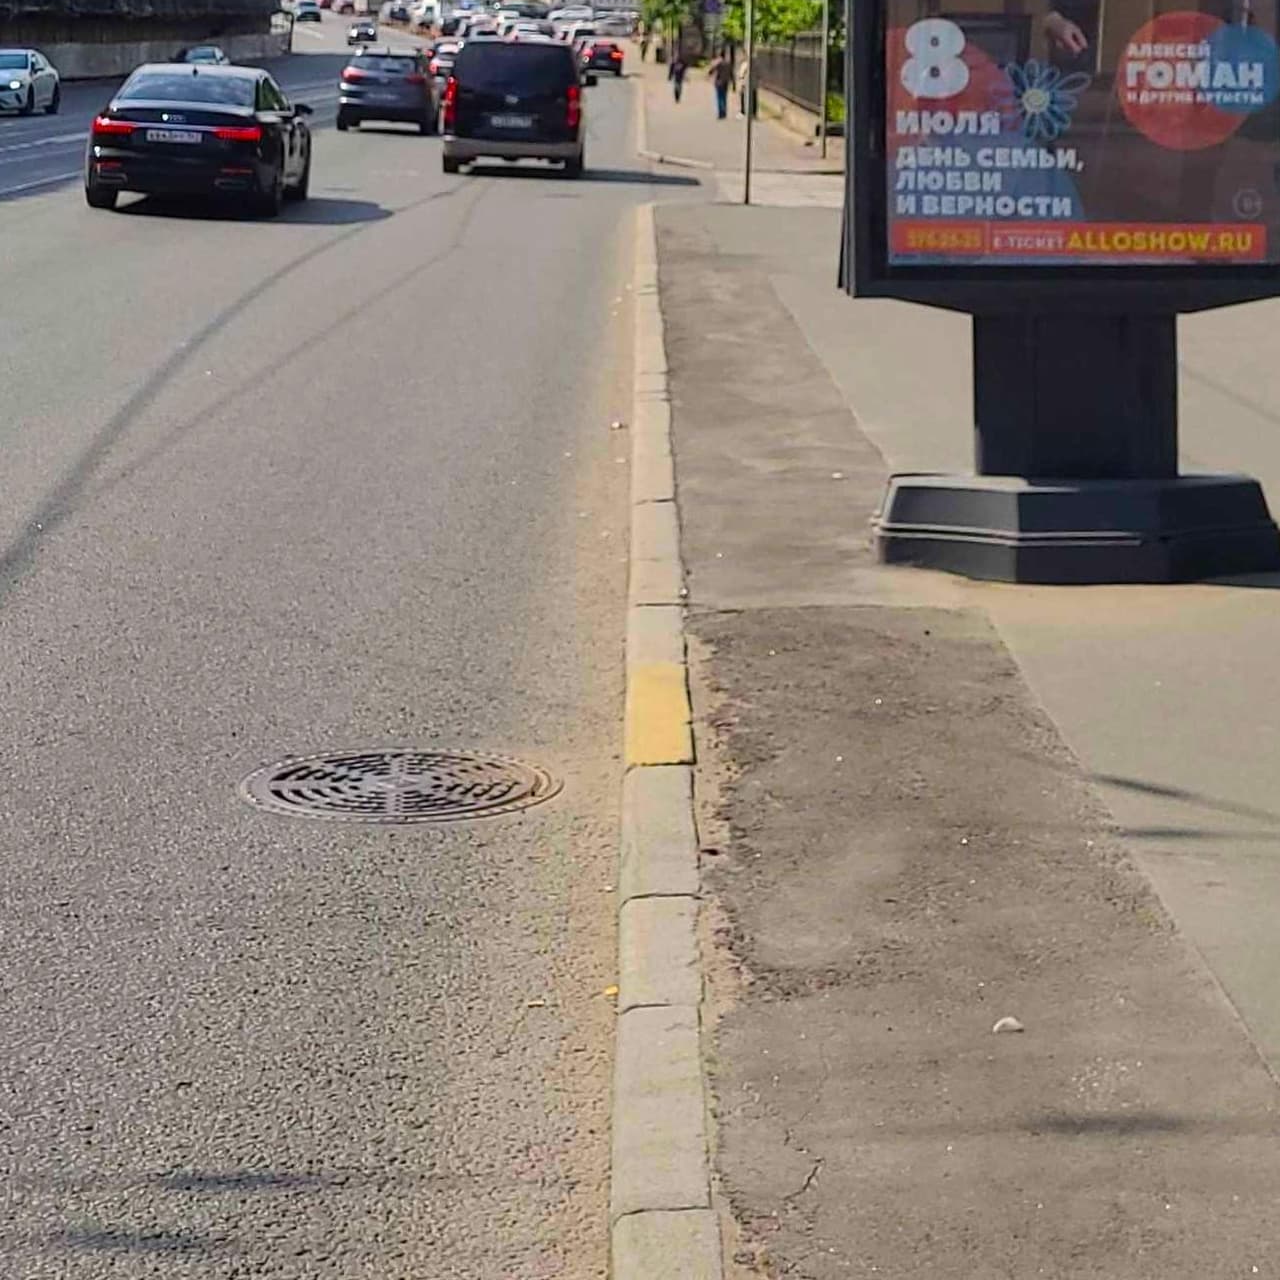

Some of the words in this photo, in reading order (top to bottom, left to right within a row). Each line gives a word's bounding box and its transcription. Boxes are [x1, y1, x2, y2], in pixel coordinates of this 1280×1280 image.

[901, 18, 970, 100] 8
[1127, 40, 1211, 57] АЛЕКСЕЙ
[1126, 61, 1264, 89] ГОМАН
[1127, 90, 1138, 104] И
[1139, 90, 1193, 104] ДРУГИЕ
[1195, 90, 1263, 104] АРТИСТЫ
[896, 110, 1001, 134] ИЮЛЯ
[896, 147, 971, 169] ДЕНЬ
[976, 147, 1084, 172] СЕМЬИ,
[896, 171, 1003, 191] ЛЮБВИ
[896, 195, 916, 215] И
[921, 195, 1072, 216] ВЕРНОСТИ
[1068, 231, 1252, 251] ALLOSHOW.RU
